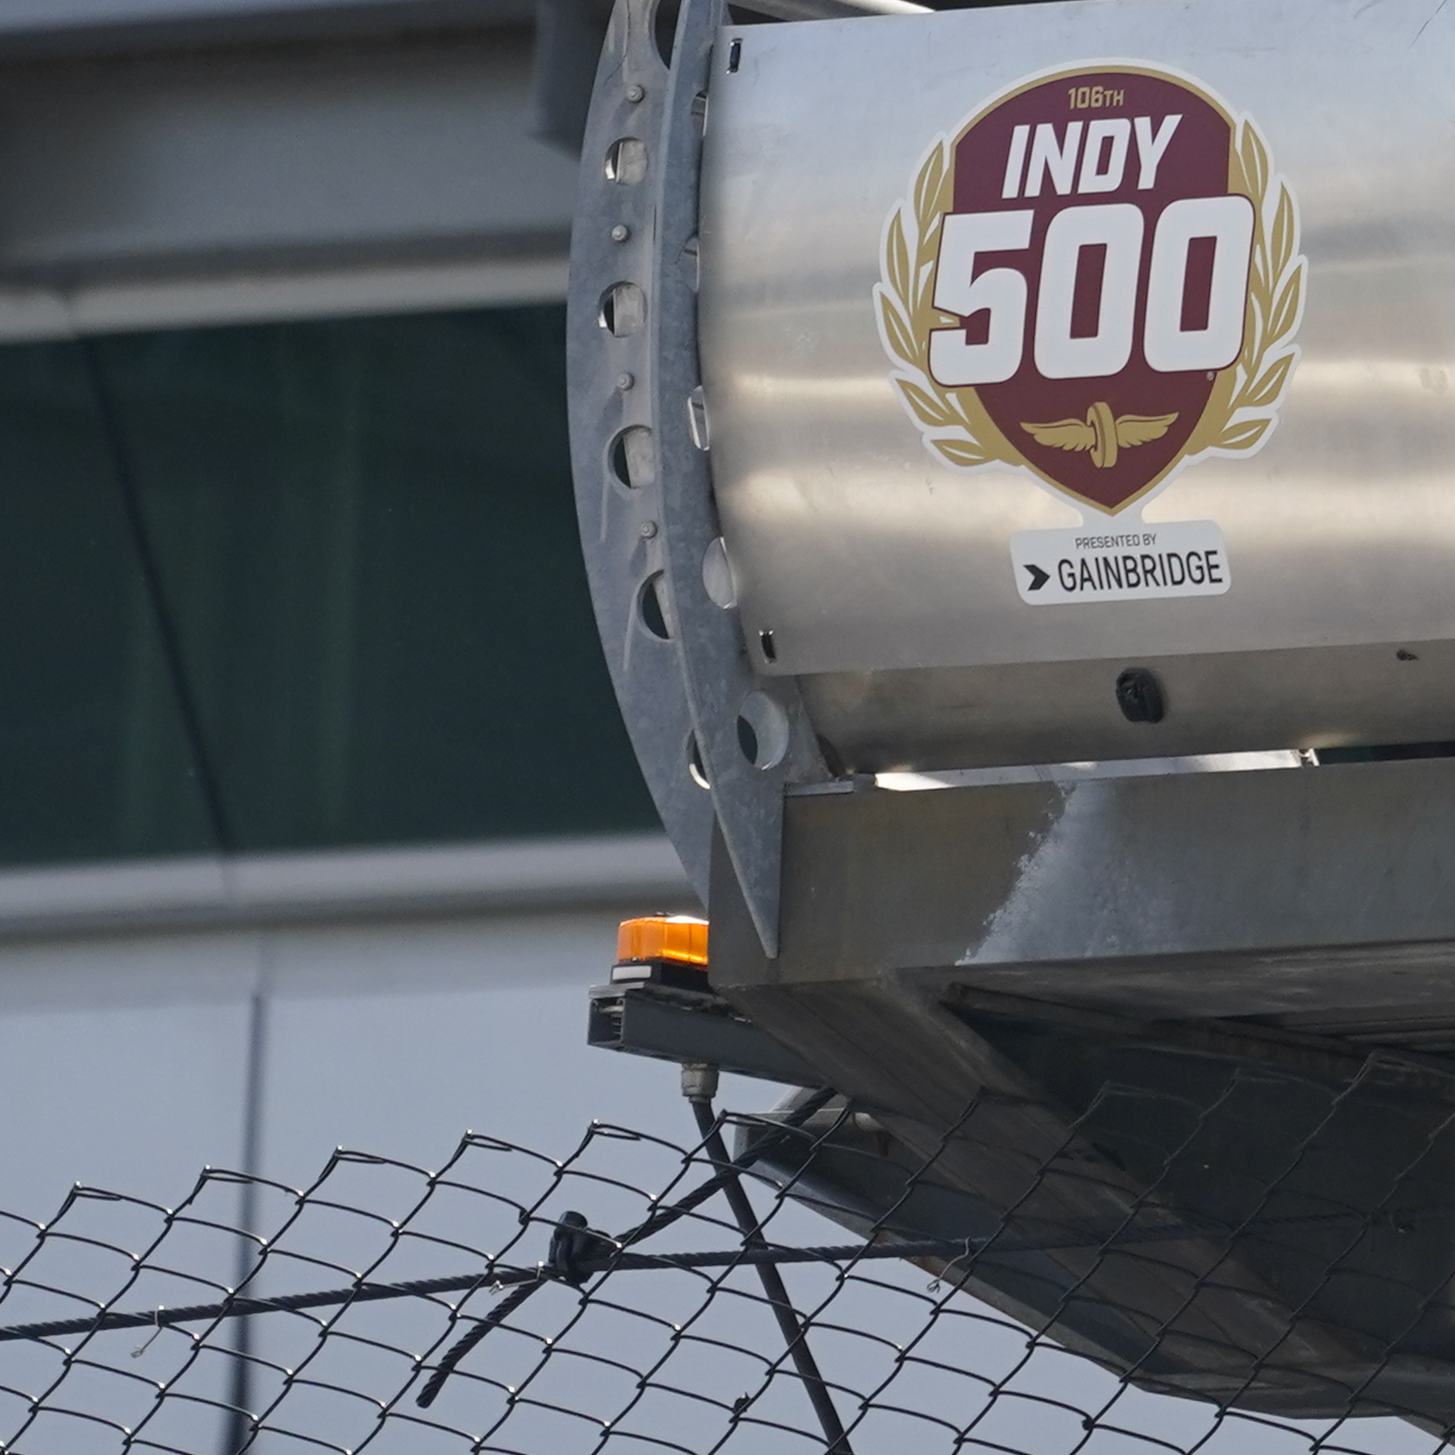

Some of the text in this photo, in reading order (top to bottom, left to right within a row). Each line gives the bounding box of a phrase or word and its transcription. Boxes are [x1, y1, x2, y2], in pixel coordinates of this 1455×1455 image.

[1068, 86, 1125, 110] 106TH
[1001, 114, 1183, 200] INDY
[928, 195, 1255, 387] 500
[1075, 533, 1157, 549] PRESENTED BY
[1058, 550, 1223, 592] GAINBRIDGE
